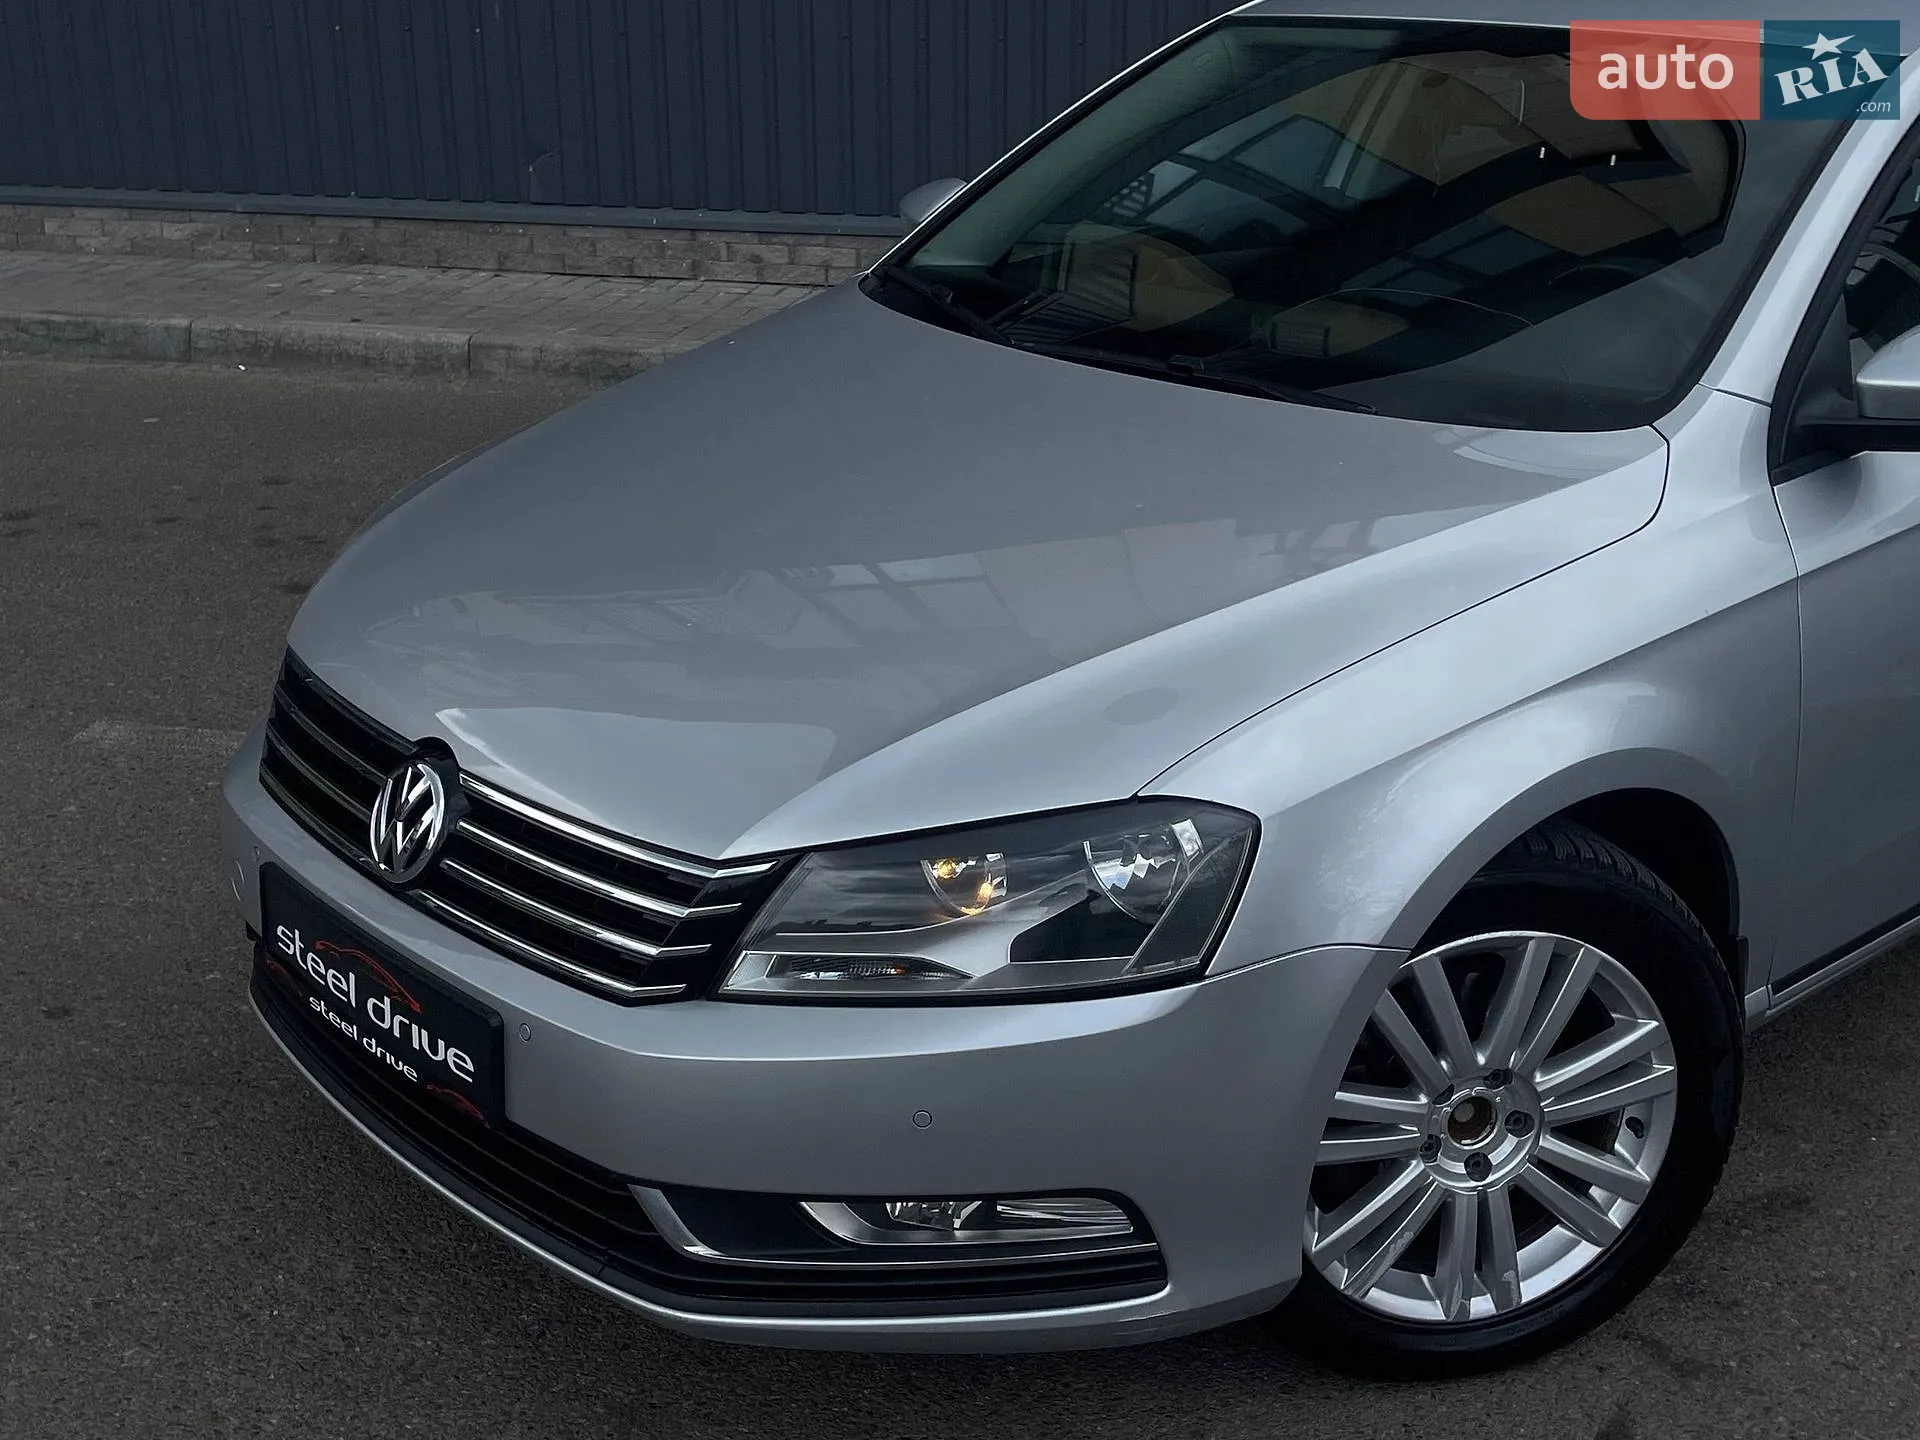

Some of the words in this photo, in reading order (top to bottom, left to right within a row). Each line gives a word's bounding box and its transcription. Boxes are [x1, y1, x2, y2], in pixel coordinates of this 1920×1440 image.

[277, 924, 356, 1008] steel
[366, 996, 475, 1083] drive
[309, 996, 358, 1041] steel
[362, 1037, 418, 1082] drive
